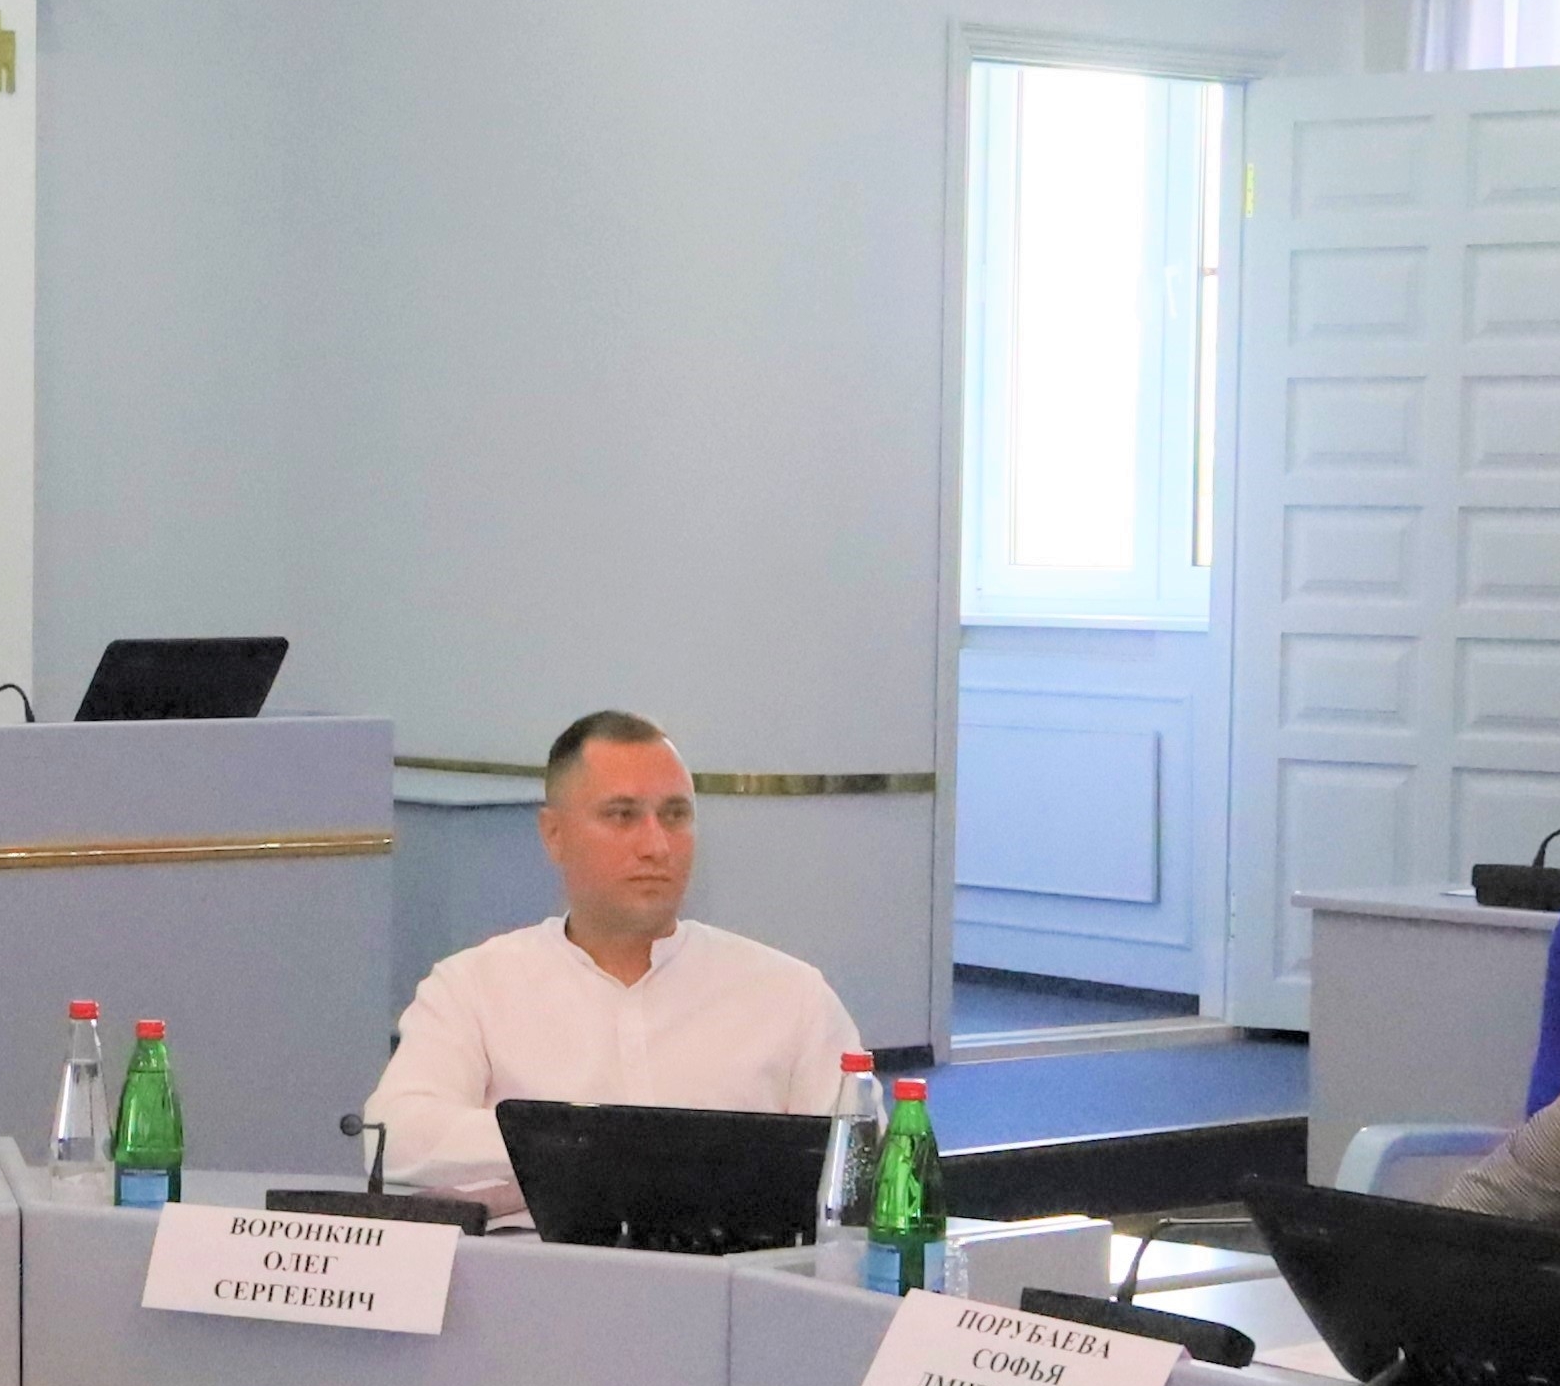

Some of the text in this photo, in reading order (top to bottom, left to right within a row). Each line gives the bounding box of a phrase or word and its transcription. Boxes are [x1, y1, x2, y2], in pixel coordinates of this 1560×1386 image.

[230, 1216, 384, 1247] ВОРОНКИН
[263, 1250, 338, 1275] ОЛЕГ
[213, 1279, 375, 1312] СЕРГЕЕВИЧ
[956, 1309, 1111, 1359] ПОРУБАЕВА
[972, 1348, 1067, 1386] СОФЬЯ
